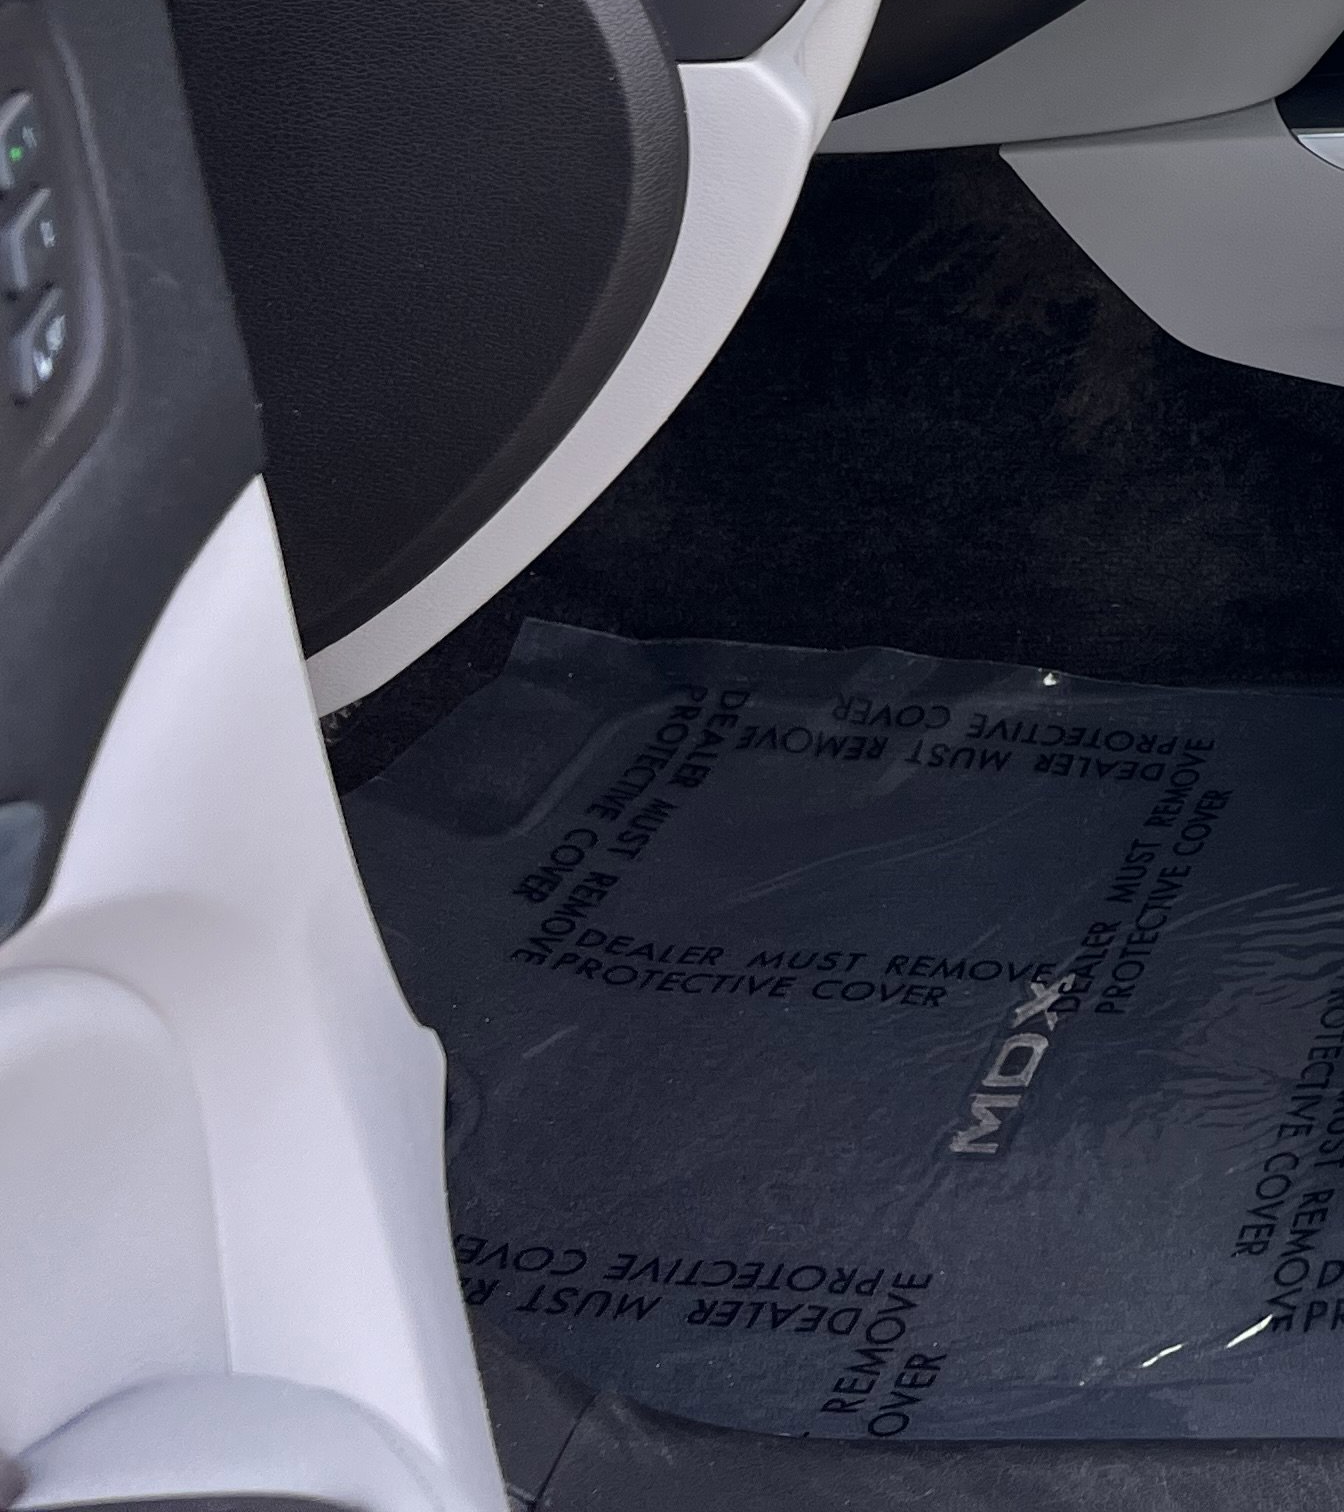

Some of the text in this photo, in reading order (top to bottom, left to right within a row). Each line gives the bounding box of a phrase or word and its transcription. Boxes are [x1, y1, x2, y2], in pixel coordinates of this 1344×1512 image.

[737, 726, 1163, 783] DEALER MUST REMOVE
[830, 691, 1179, 755] PROTECTIVE COVER
[509, 686, 708, 905] PROTECTIVE COVER
[509, 688, 752, 967] DEALER MUST REMOVE
[1047, 736, 1216, 1014] DEALER MUST REMOVE
[1095, 789, 1234, 1016] PROTECTIVE COVER
[547, 953, 949, 1008] PROTECTIVE COVER
[574, 927, 1057, 984] DEALER MUST REMOVE
[949, 972, 1076, 1155] MDX
[1231, 1151, 1299, 1259] COVER
[516, 1289, 664, 1322] MUST
[603, 1252, 884, 1298] PROTECTIVE
[1264, 1187, 1336, 1334] REMOVE
[686, 1298, 863, 1336] DEALER
[820, 1272, 934, 1414] REMOVE
